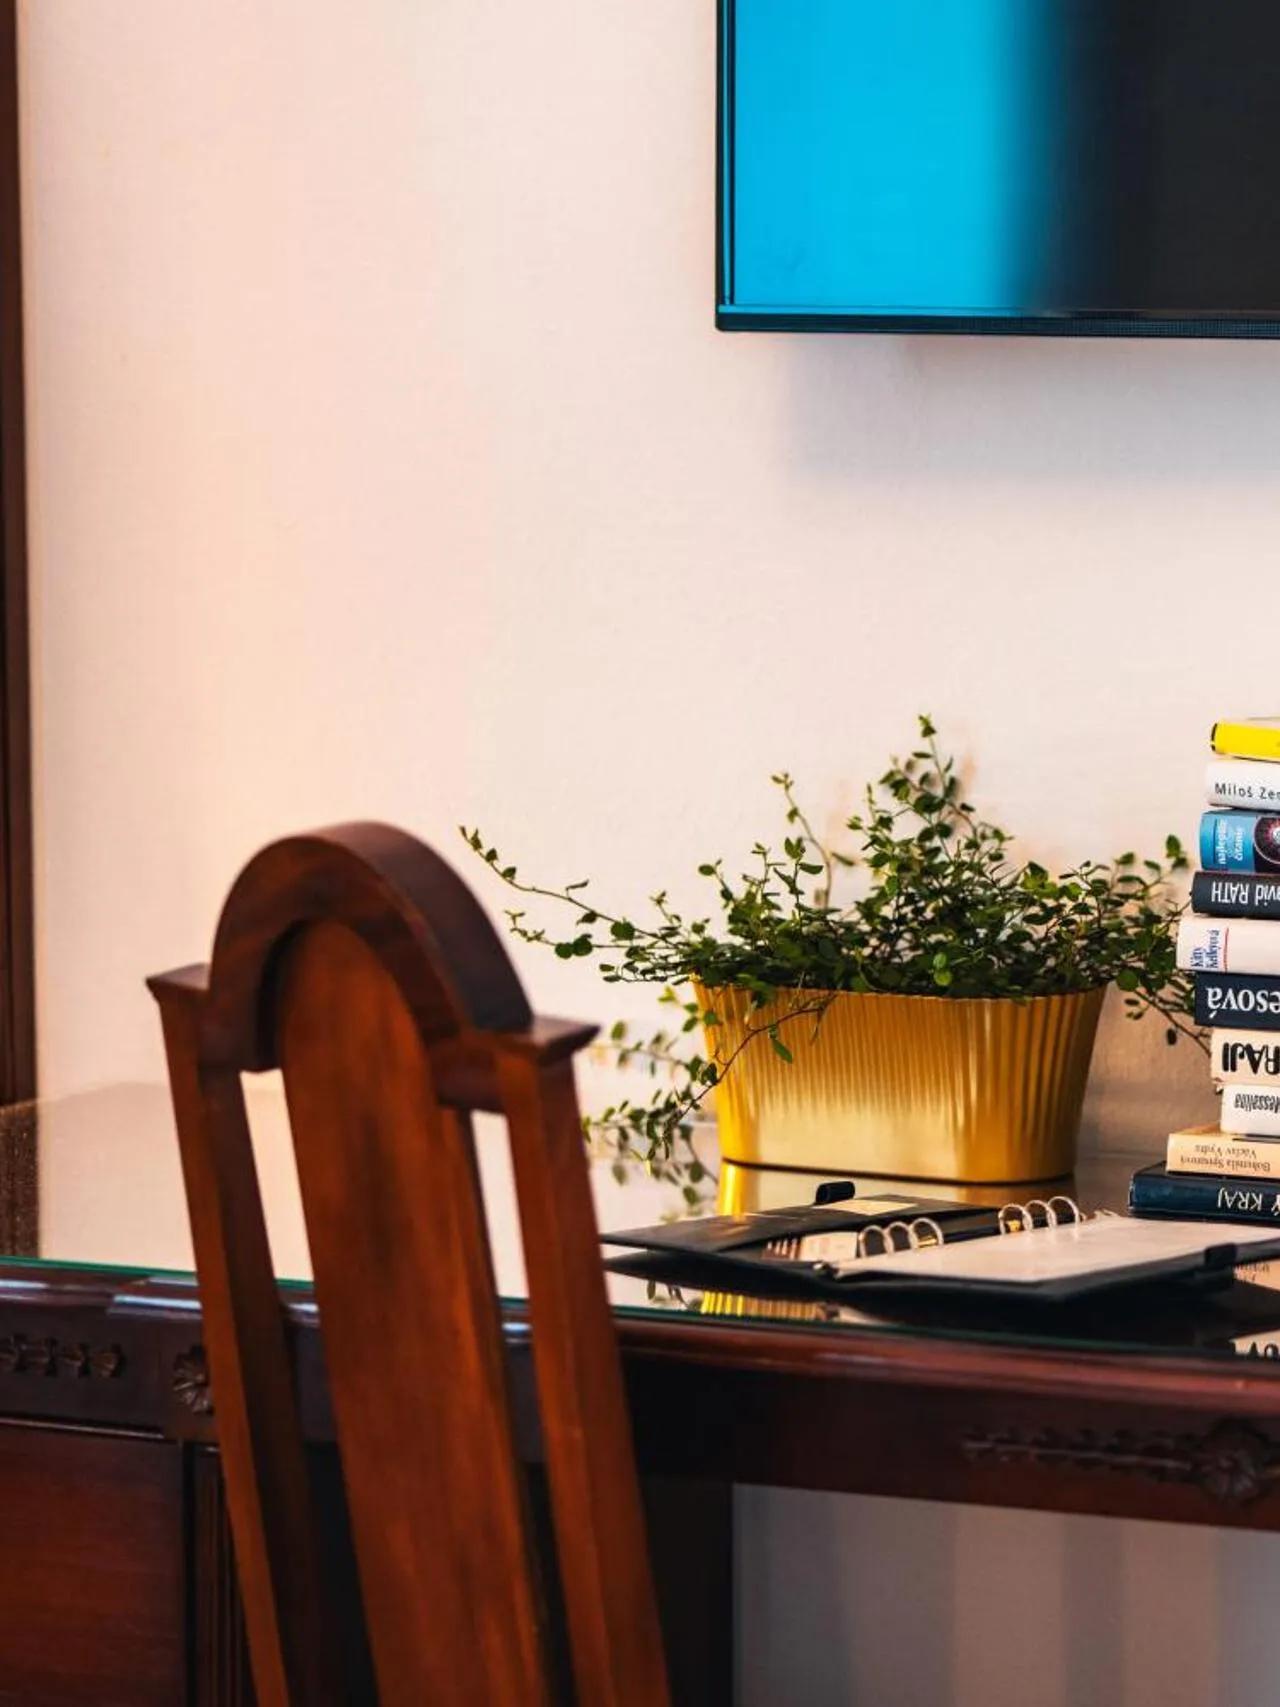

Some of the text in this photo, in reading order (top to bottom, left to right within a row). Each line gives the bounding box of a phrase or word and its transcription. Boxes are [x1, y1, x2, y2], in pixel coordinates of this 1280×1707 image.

[1214, 782, 1255, 799] Miloš
[1210, 881, 1250, 903] RATH
[1217, 1188, 1262, 1212] KRAJ
